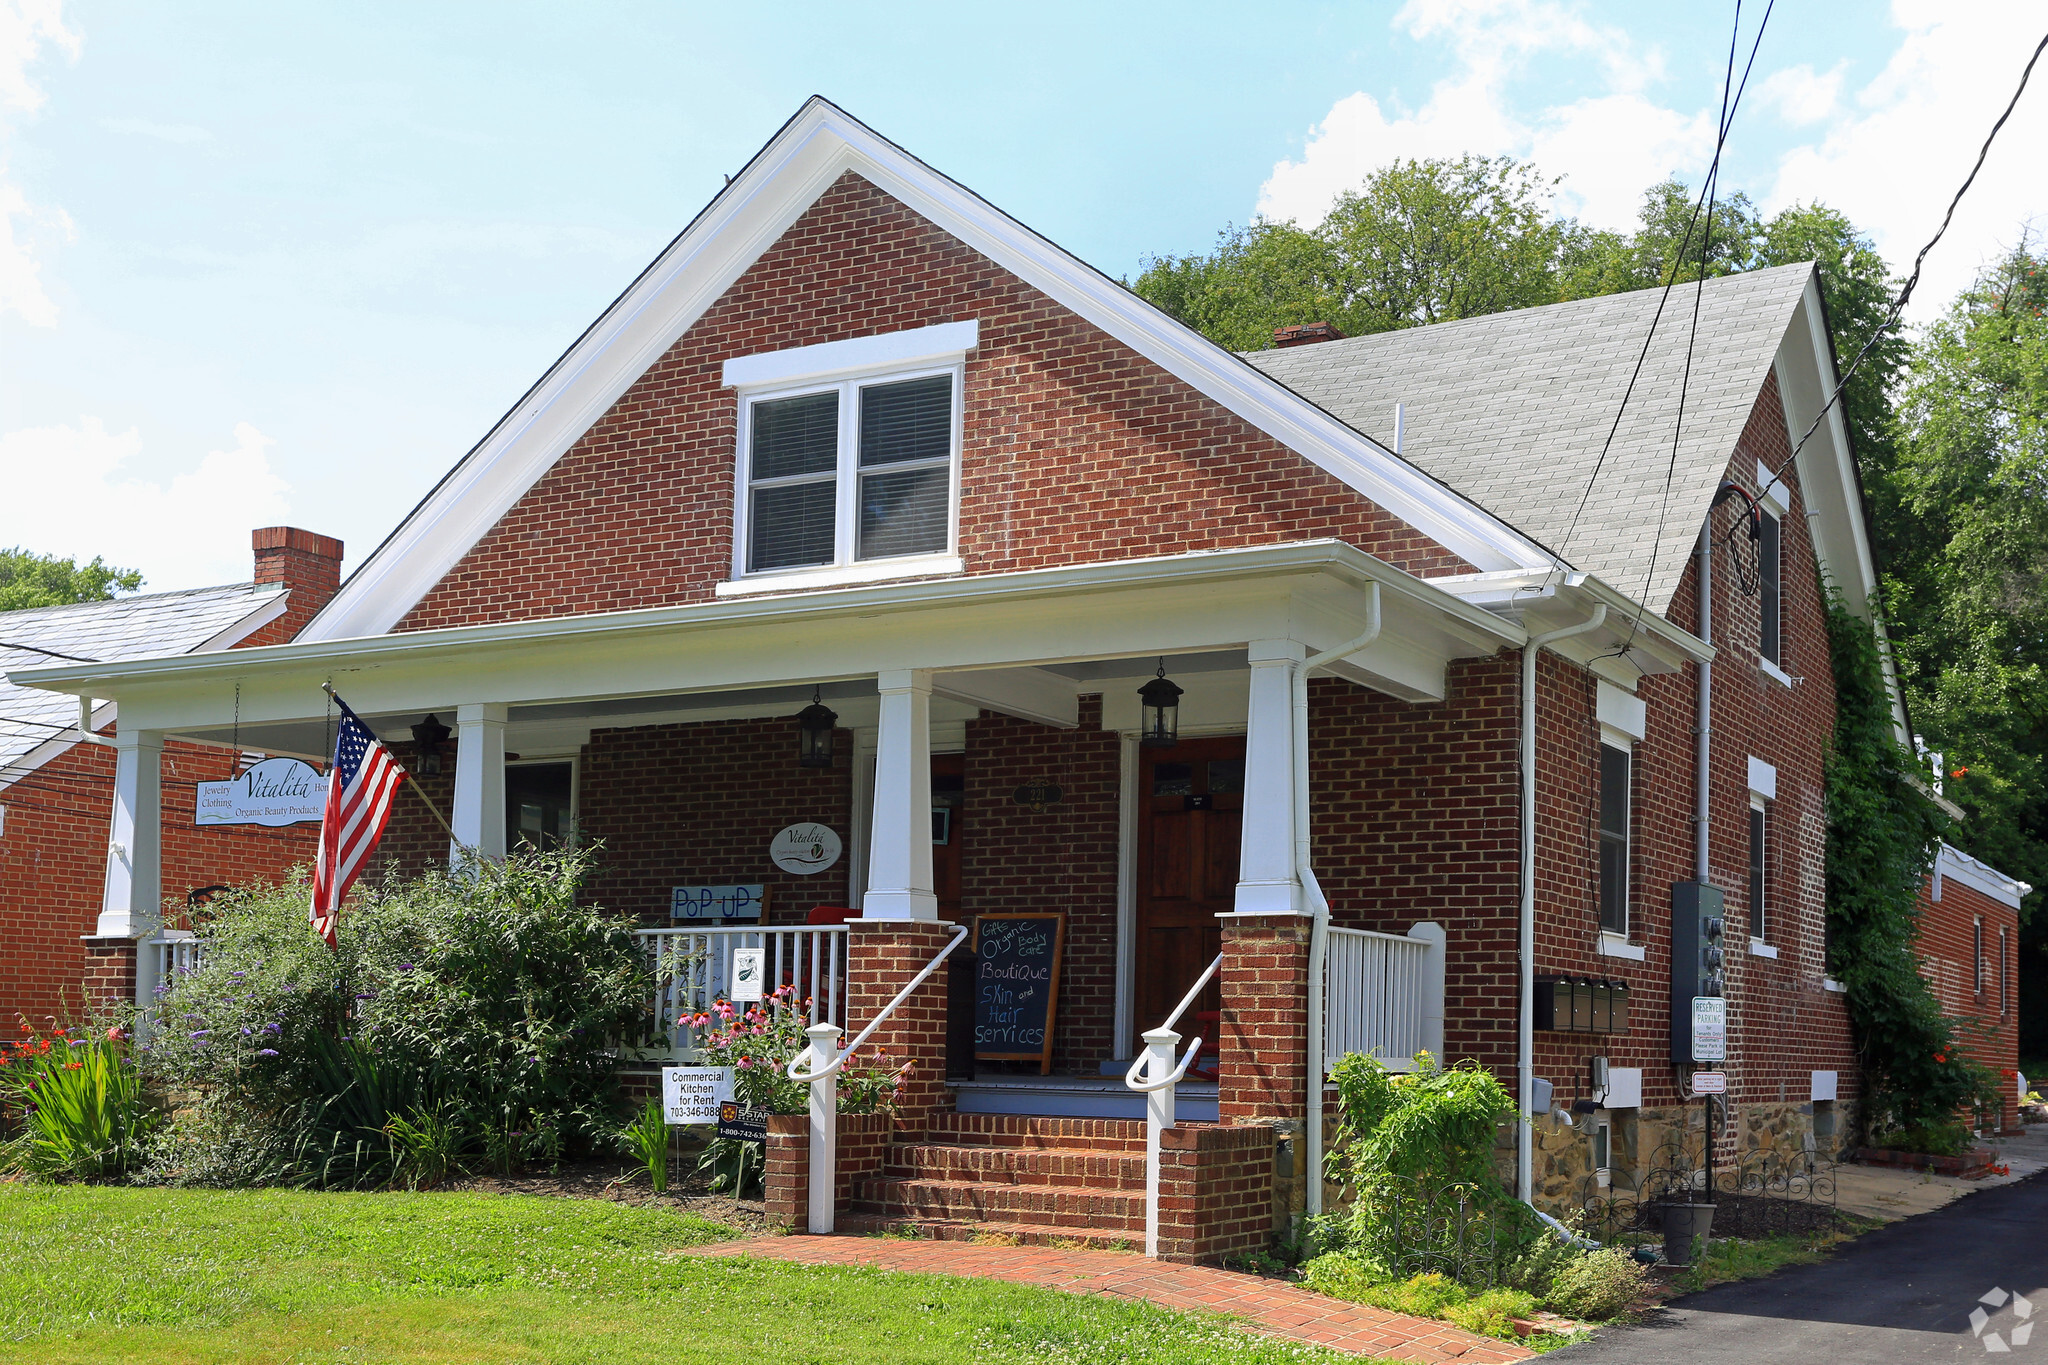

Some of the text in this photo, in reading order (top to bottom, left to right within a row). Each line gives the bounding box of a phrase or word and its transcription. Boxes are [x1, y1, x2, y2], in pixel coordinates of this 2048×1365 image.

[245, 762, 312, 798] Vitalitá
[203, 786, 231, 796] Jewelry
[201, 798, 232, 809] Clothing
[235, 805, 319, 818] Organic Beauty Products
[982, 921, 1009, 936] Gifts
[982, 921, 1038, 958] Organic
[1018, 985, 1034, 999] and
[988, 1005, 1024, 1023] Hair
[1696, 1003, 1723, 1013] RESERVED
[1697, 1014, 1721, 1024] PARKING
[975, 1025, 1044, 1045] Services
[672, 1071, 724, 1082] Commercial
[680, 1084, 714, 1094] Kitchen
[680, 1095, 714, 1105] for Rent
[671, 1106, 720, 1118] 703-346-088
[720, 1127, 767, 1139] 1-800-742-636
